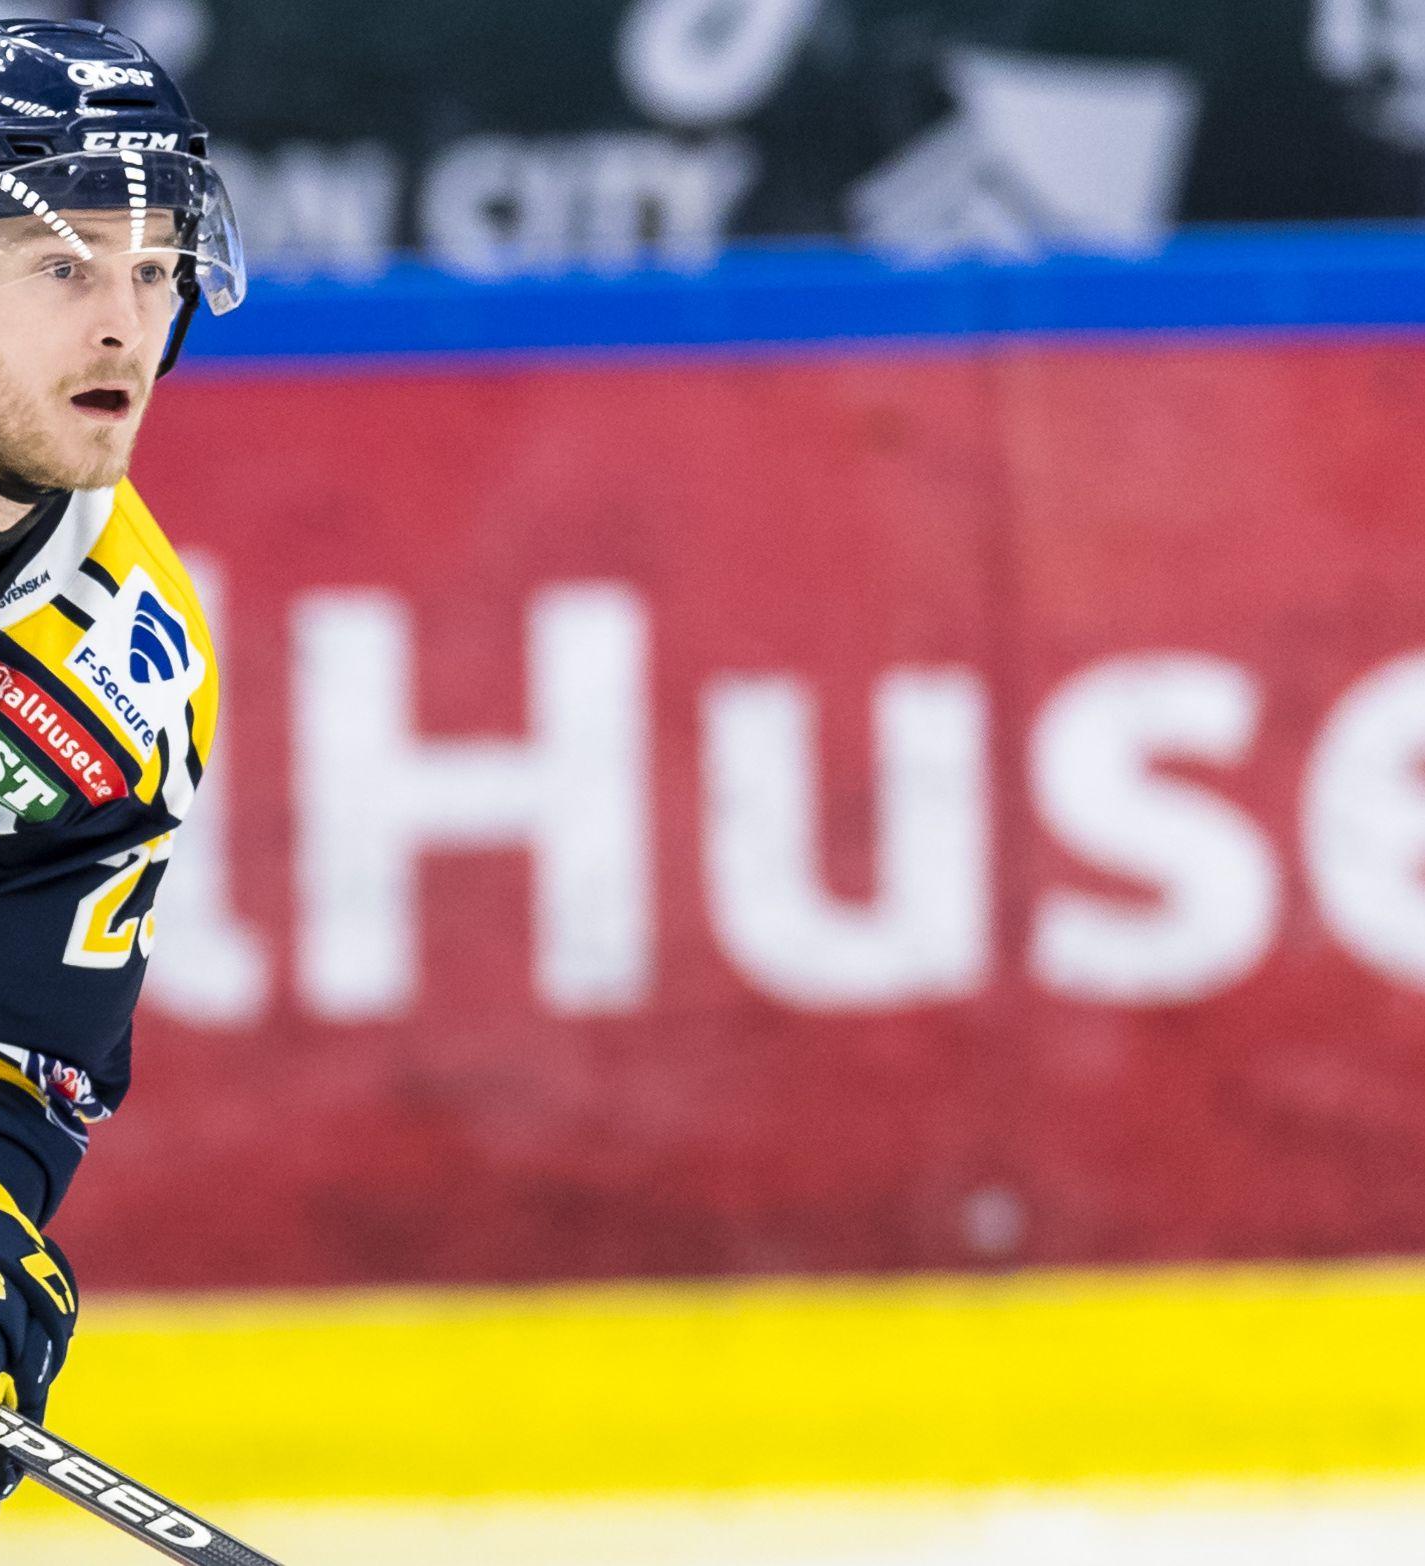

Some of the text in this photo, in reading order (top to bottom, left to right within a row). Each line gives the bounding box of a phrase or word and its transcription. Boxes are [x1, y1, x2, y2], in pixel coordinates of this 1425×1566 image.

[82, 132, 178, 152] CCM
[73, 646, 156, 748] F-Secure
[62, 831, 174, 969] 2
